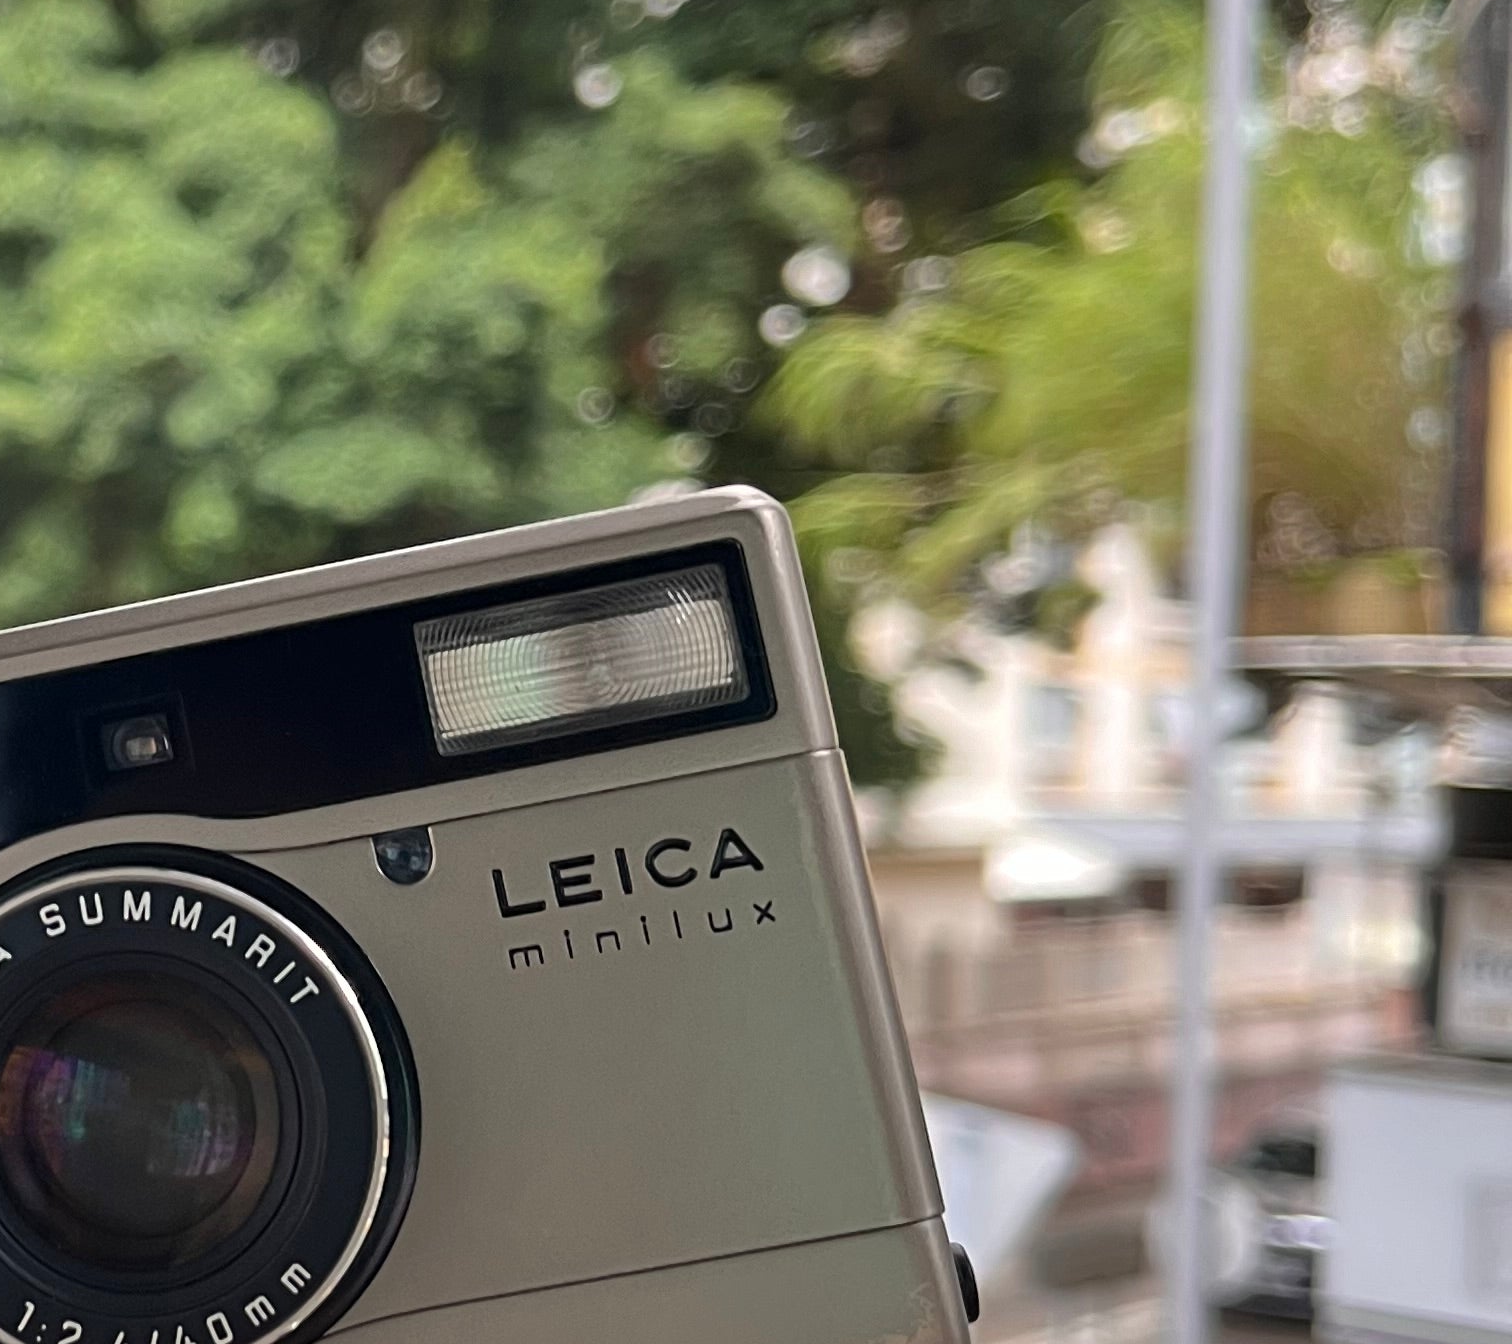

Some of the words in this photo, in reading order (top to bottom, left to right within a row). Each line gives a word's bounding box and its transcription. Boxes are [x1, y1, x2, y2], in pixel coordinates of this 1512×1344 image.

[491, 828, 764, 919] LEICA
[38, 889, 321, 1004] SUMMARIT
[508, 900, 776, 970] minilux
